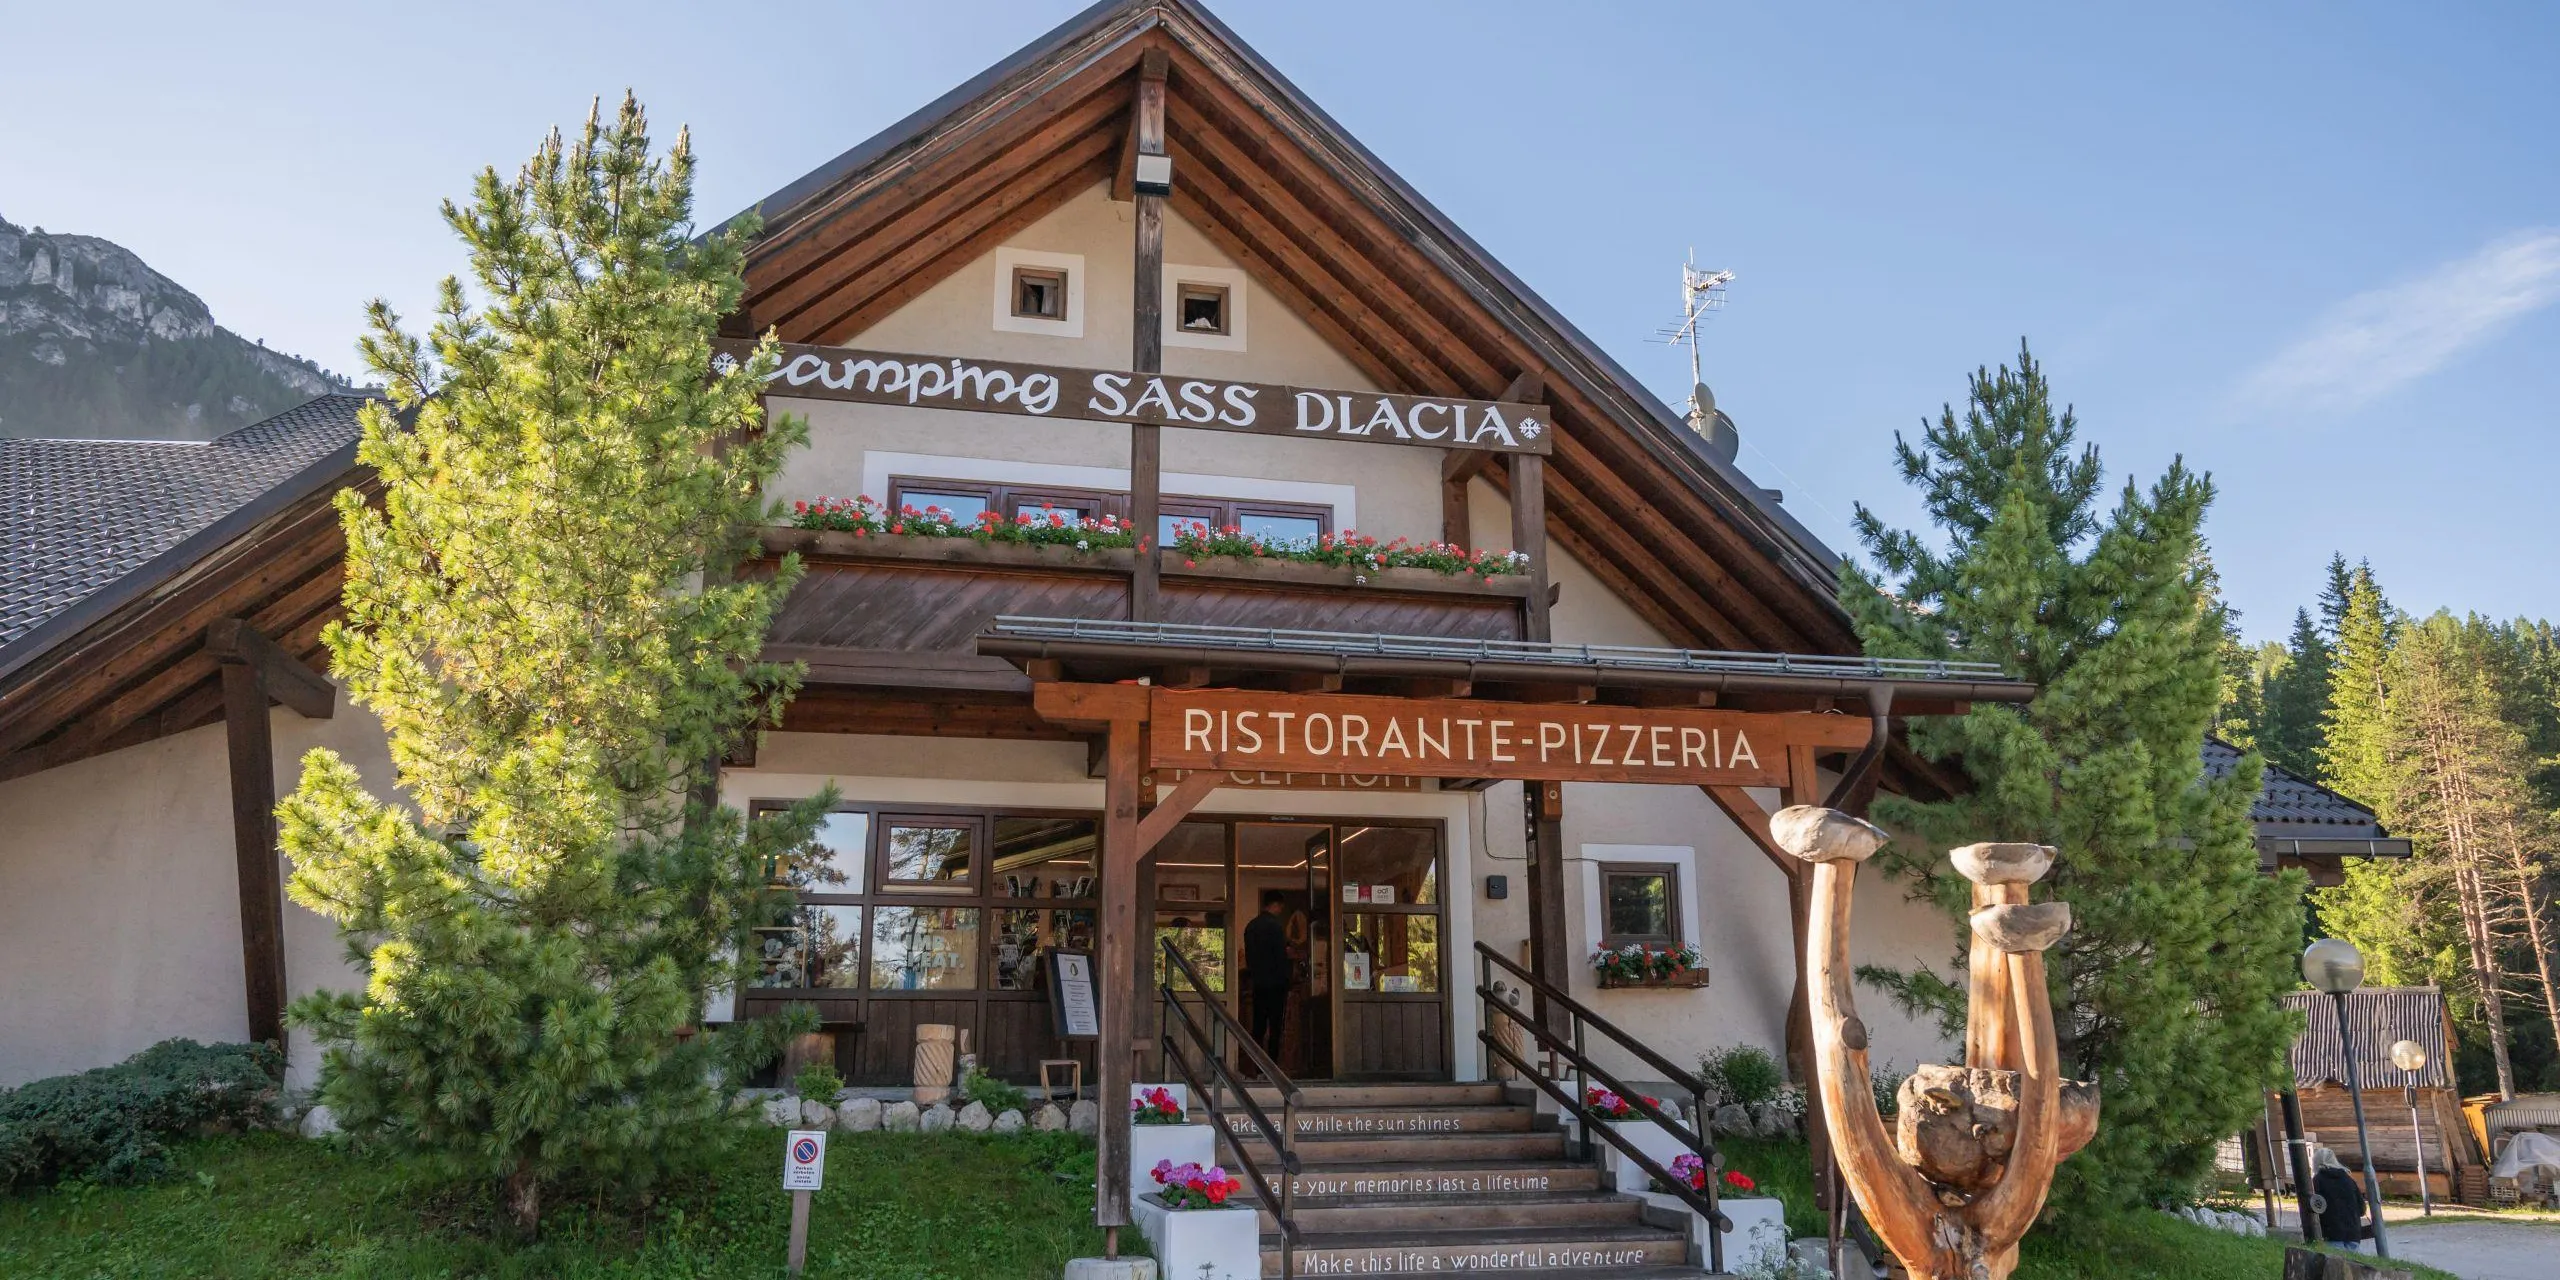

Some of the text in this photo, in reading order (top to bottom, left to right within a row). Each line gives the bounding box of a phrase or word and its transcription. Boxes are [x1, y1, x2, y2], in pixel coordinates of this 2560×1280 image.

[1089, 373, 1259, 427] SASS
[1294, 391, 1518, 446] DLACIA
[1185, 708, 1759, 769] RISTORANTE-PIZZERIA
[1226, 1116, 1258, 1132] ake
[1298, 1115, 1342, 1132] while
[1347, 1115, 1372, 1131] the
[1378, 1119, 1404, 1131] sun
[1409, 1114, 1460, 1131] shines
[1307, 1179, 1348, 1196] your
[1354, 1175, 1432, 1194] memories
[1438, 1175, 1465, 1192] last
[1472, 1177, 1481, 1190] a
[1487, 1174, 1549, 1190] lifetime
[1304, 1248, 1644, 1274] Make this life a wonderful adventure
